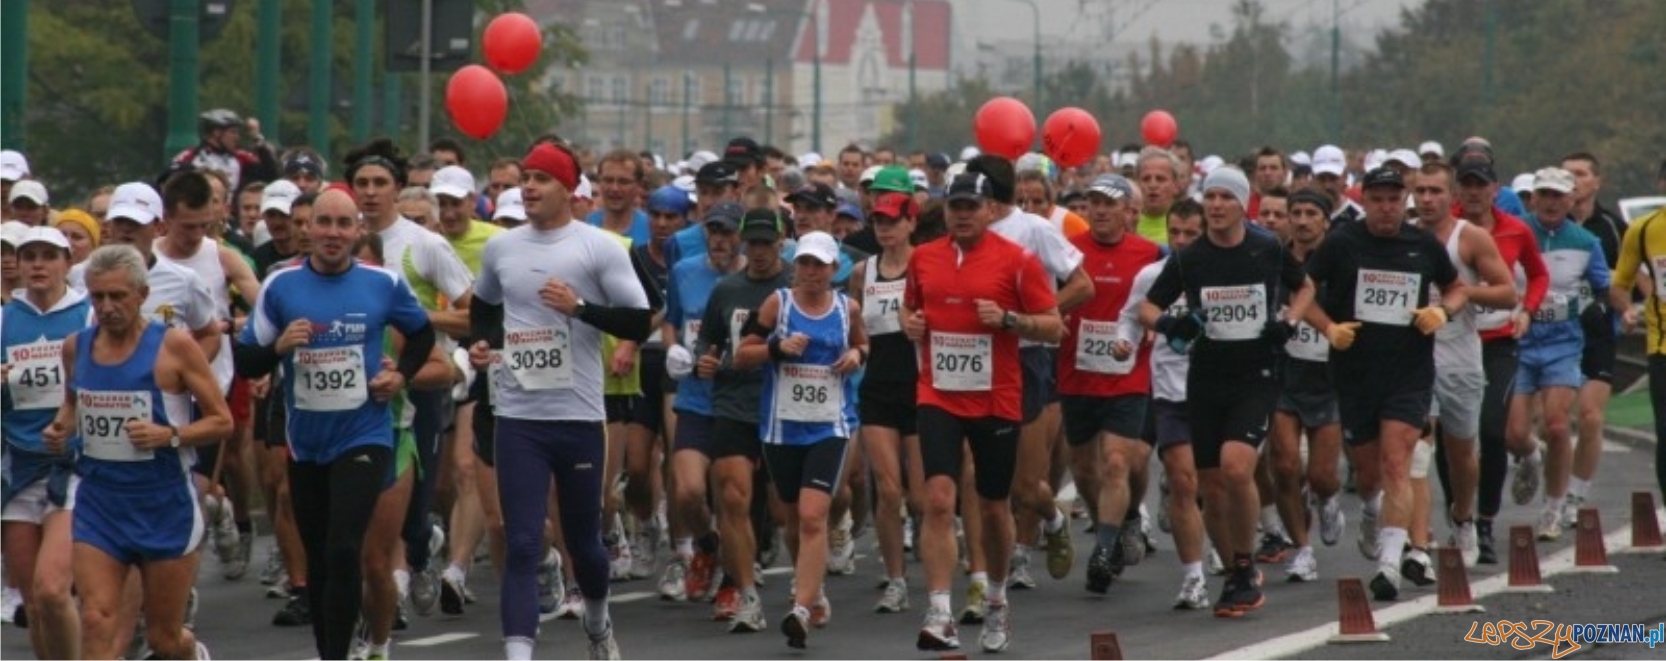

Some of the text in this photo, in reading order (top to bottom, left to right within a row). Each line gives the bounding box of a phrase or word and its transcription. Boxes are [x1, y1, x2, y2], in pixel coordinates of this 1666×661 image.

[1363, 273, 1376, 284] 10
[1206, 291, 1219, 301] 10
[1364, 288, 1408, 307] 2871
[1211, 304, 1258, 322] 2904
[505, 332, 520, 345] 10
[12, 348, 30, 362] 10
[300, 351, 311, 364] 10
[510, 348, 563, 370] 3038
[936, 353, 983, 372] 2076
[19, 367, 62, 388] 451
[783, 366, 799, 377] 10
[304, 369, 356, 391] 1392
[79, 393, 92, 408] 10
[792, 384, 828, 404] 936
